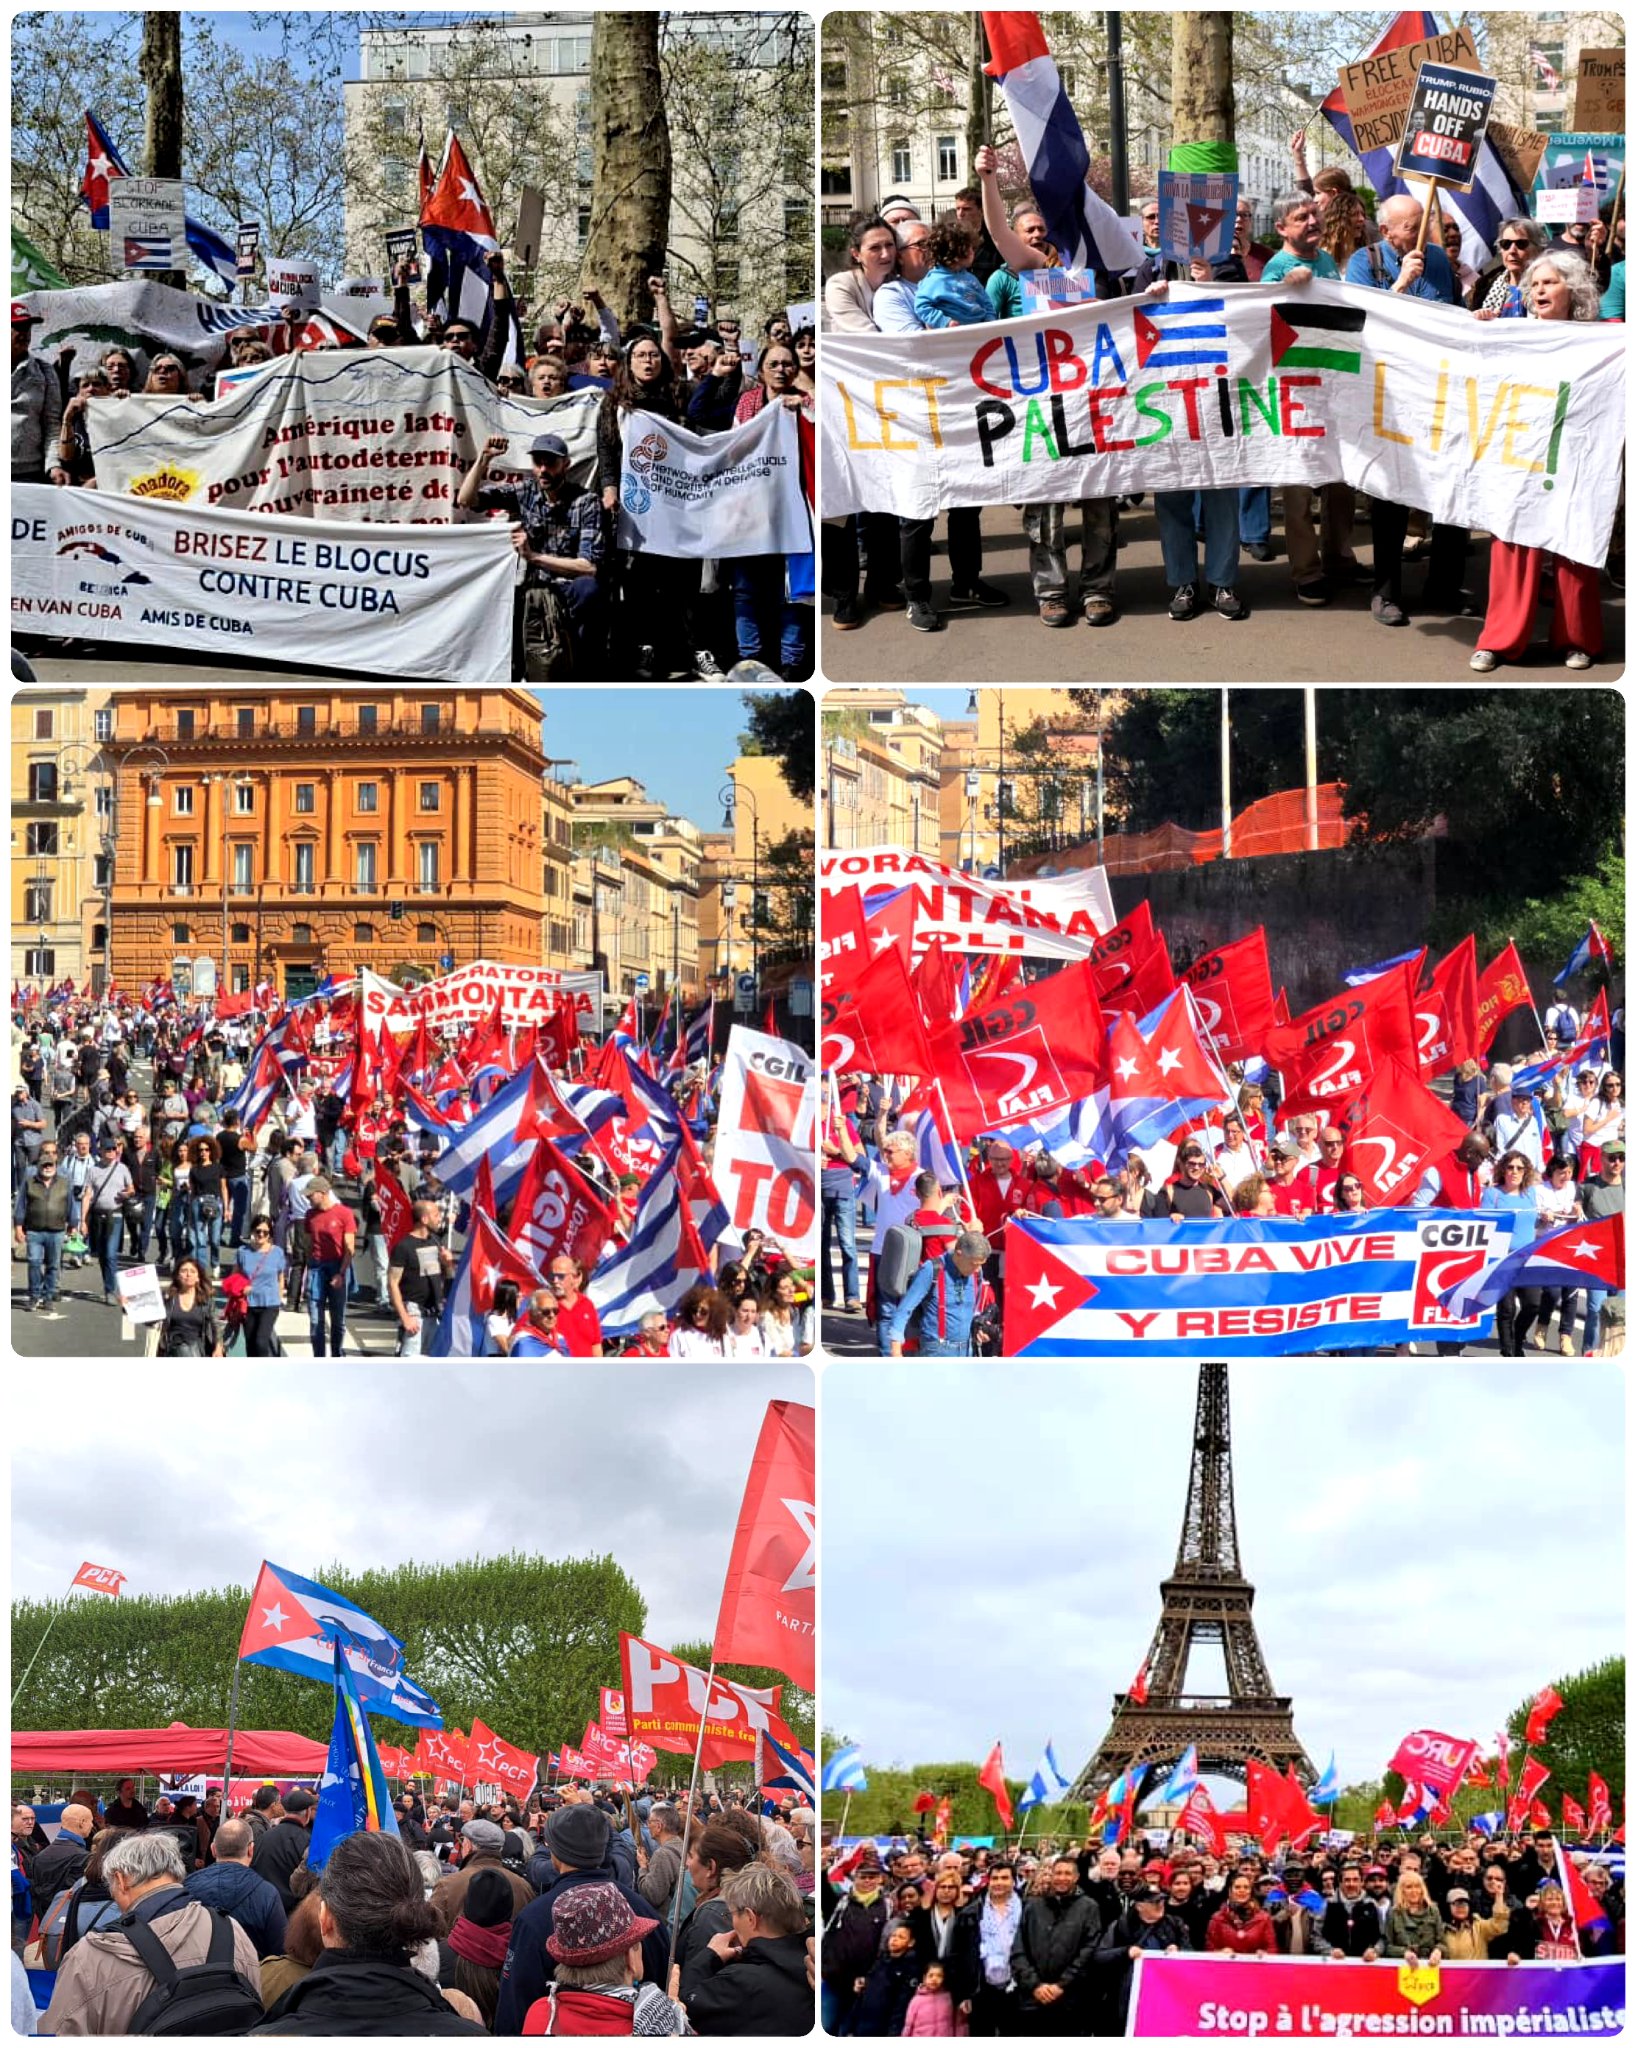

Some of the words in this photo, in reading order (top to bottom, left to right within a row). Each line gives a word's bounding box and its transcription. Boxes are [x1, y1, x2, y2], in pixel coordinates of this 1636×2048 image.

[1346, 53, 1403, 91] FREE
[1409, 32, 1472, 72] CUBA
[1421, 75, 1457, 90] TRUMP,
[1458, 84, 1493, 98] RUBIO:
[1423, 90, 1483, 120] HANDS
[1433, 114, 1465, 138] OFF
[1417, 134, 1467, 165] CUBA.
[128, 221, 169, 234] CUBA
[280, 283, 303, 297] CUBA
[969, 322, 1127, 399] CUBA
[836, 377, 948, 451] LET
[974, 364, 1326, 467] PALESTINE
[1373, 358, 1571, 492] LIVE!
[262, 415, 395, 448] Amérique
[208, 470, 271, 504] pour
[11, 518, 47, 541] DE
[57, 524, 102, 541] AMIGOS
[107, 524, 121, 535] DE
[174, 531, 267, 561] BRISEZ
[276, 540, 307, 565] LE
[316, 547, 430, 579] BLOCUS
[200, 569, 311, 604] CONTRE
[320, 584, 400, 614] CUBA
[38, 600, 72, 615] VAN
[78, 602, 122, 620] CUBA
[140, 609, 181, 627] AMIS
[185, 615, 205, 629] DE
[210, 616, 254, 635] CUBA
[749, 1051, 807, 1084] CGIL
[1421, 1224, 1490, 1247] CGIL
[1105, 1246, 1278, 1275] CUBA
[1289, 1235, 1396, 1271] VIVE
[1115, 1312, 1161, 1338] Y
[1177, 1296, 1383, 1337] RESISTE
[316, 1633, 353, 1657] Cua
[369, 1660, 394, 1676] France
[633, 1718, 661, 1730] Parti
[498, 1762, 529, 1781] PCF
[1536, 1943, 1575, 1960] STOP
[1198, 2002, 1269, 2037] Stop
[1275, 2003, 1293, 2032] à
[1301, 2003, 1453, 2037] l'agression
